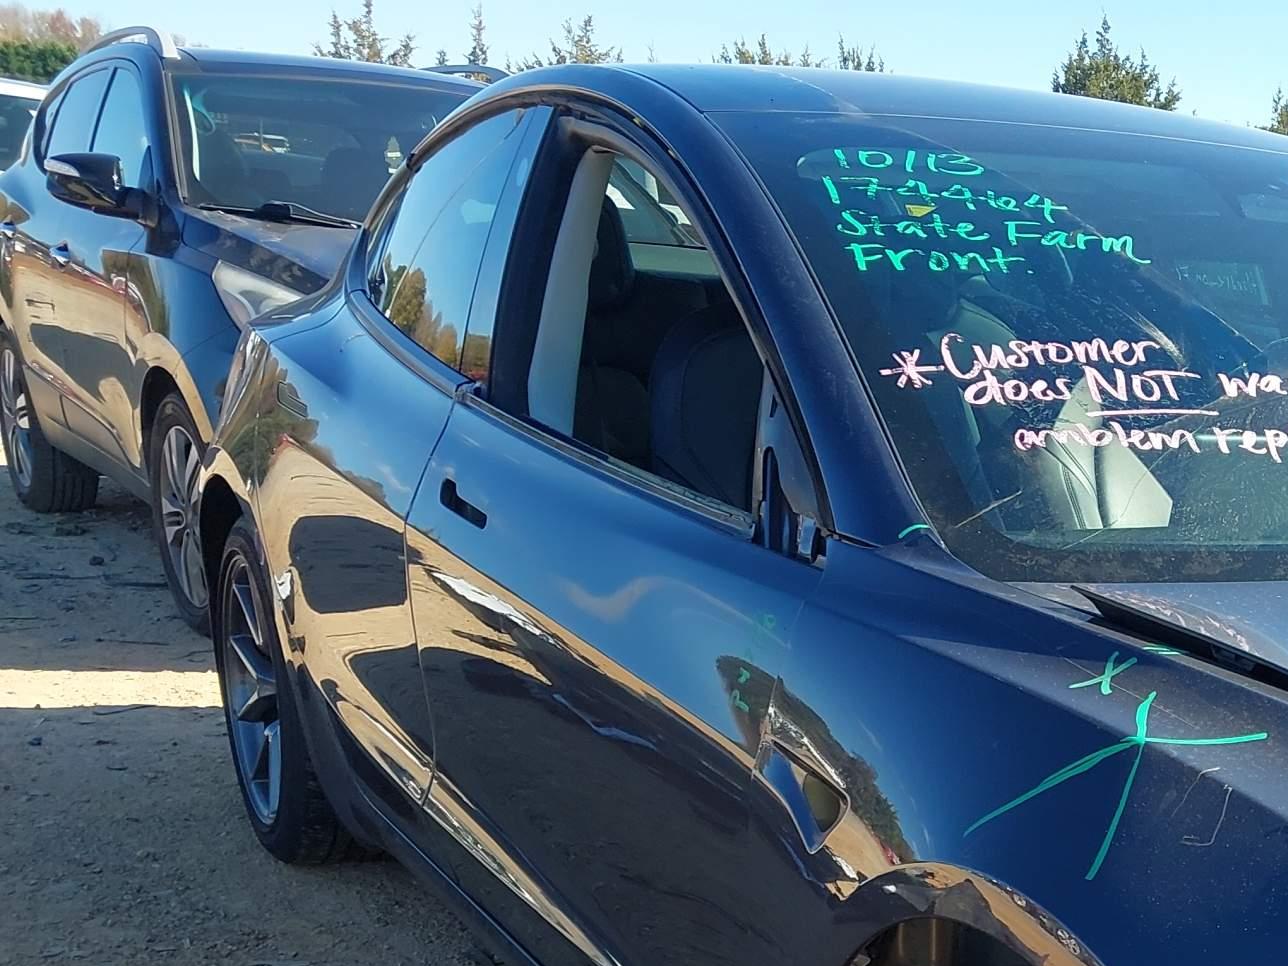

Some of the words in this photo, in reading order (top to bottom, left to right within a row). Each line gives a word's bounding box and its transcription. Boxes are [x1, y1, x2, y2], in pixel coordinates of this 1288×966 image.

[836, 209, 991, 241] State
[1003, 220, 1152, 264] Farm
[963, 369, 1073, 406] does
[1082, 365, 1202, 403] NOT
